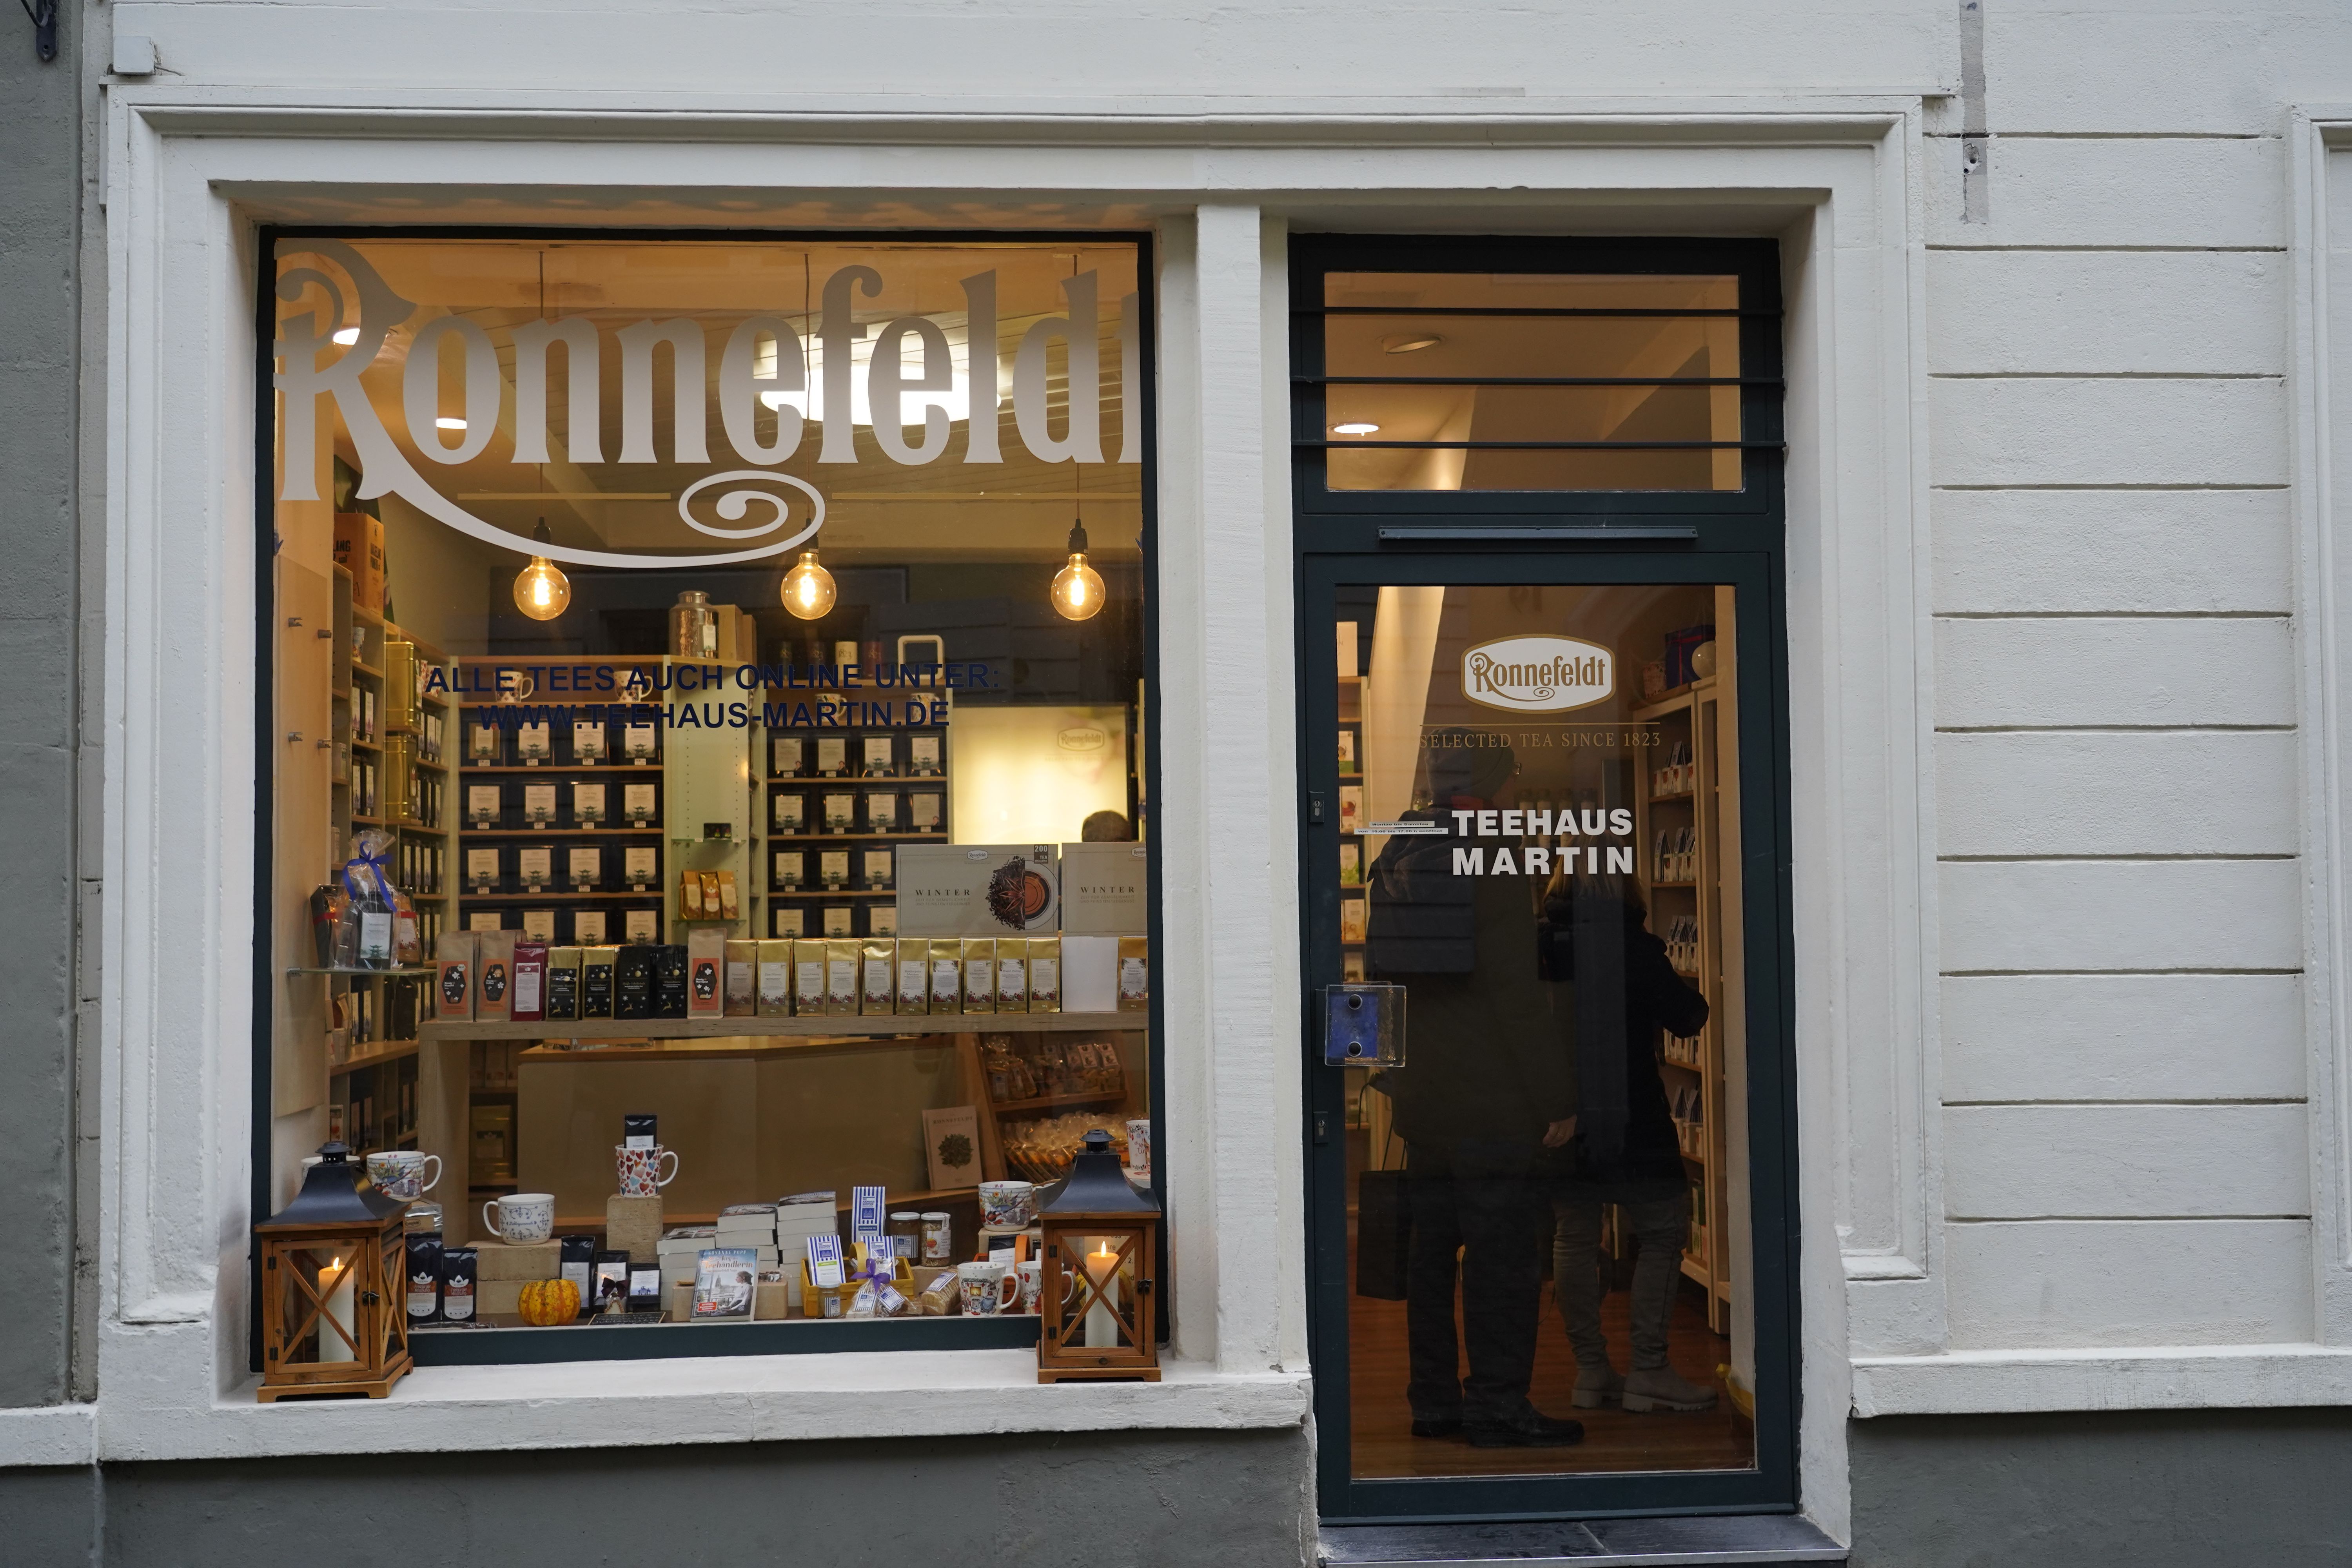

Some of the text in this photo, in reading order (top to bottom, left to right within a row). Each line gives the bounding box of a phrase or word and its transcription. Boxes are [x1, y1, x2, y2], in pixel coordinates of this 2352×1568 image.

[426, 663, 999, 692] ALLE TEES AUCH ONLINE UNTER:
[1469, 652, 1605, 702] Ronnefeldt
[478, 701, 949, 730] WWW.TEEHAUS-MARTIN.DE
[1419, 732, 1661, 749] SELECTED TEA SINCE 1823
[1452, 808, 1632, 837] TEEHAUS
[1452, 846, 1633, 876] MARTIN
